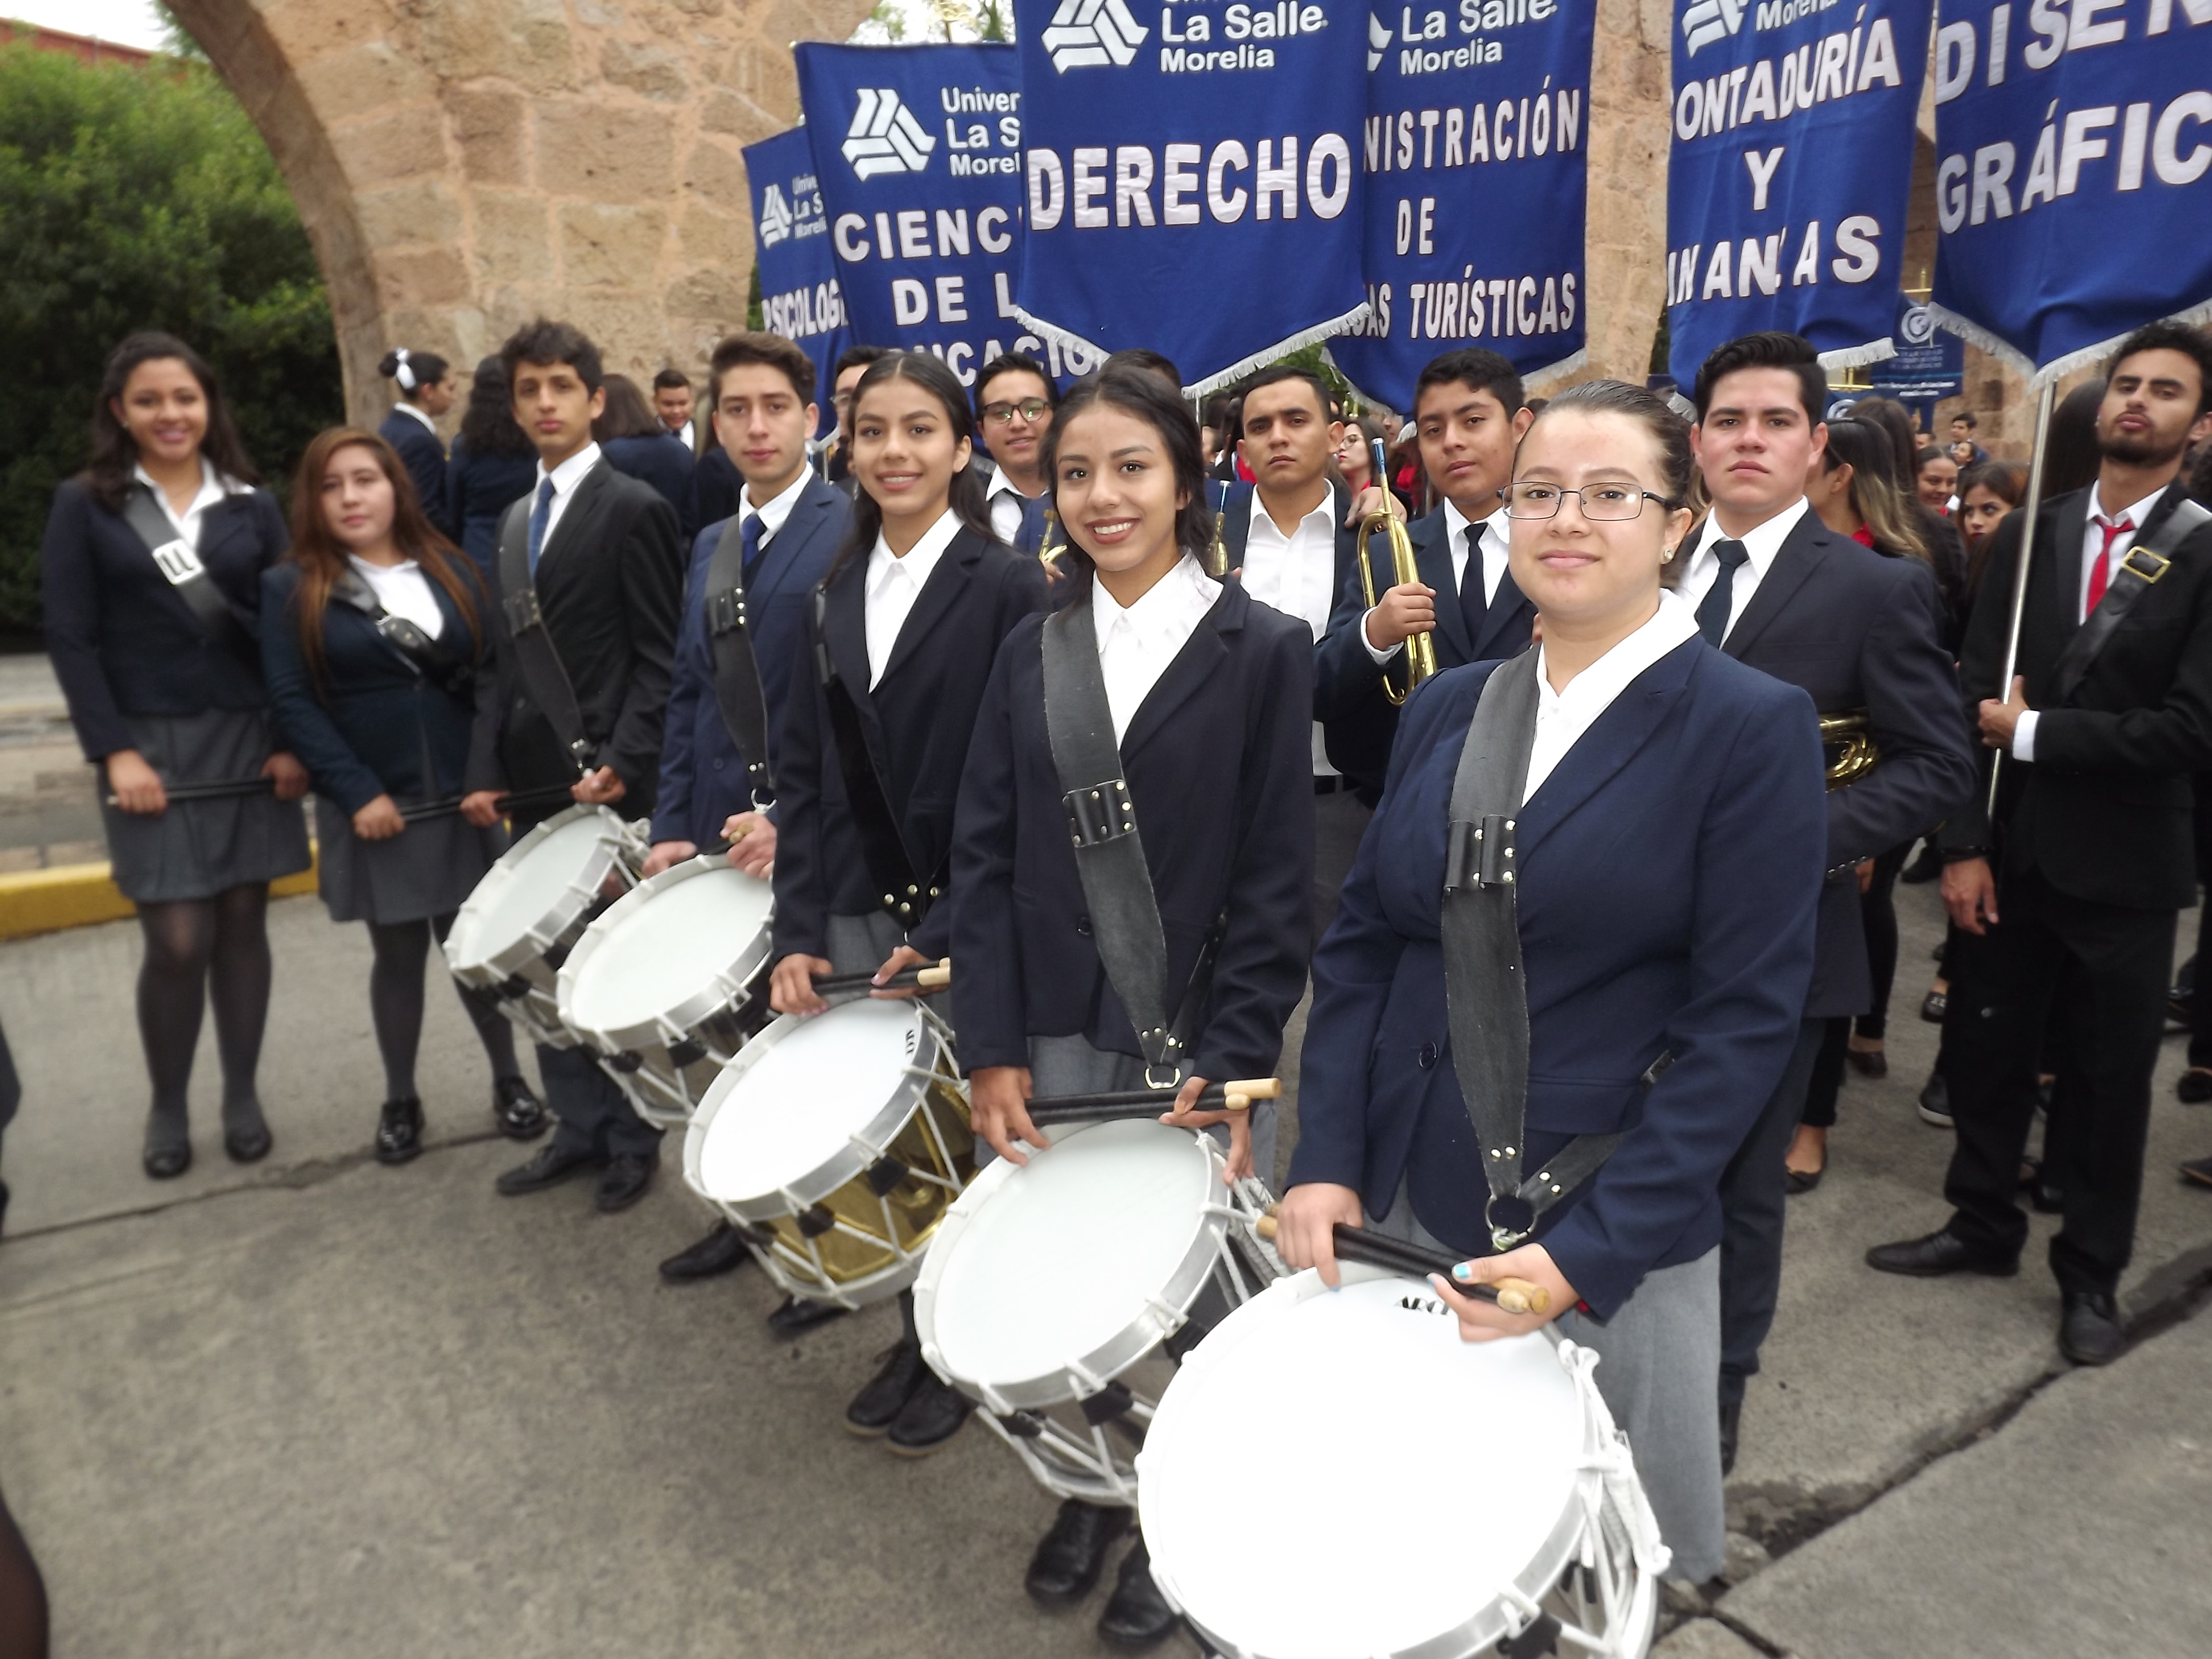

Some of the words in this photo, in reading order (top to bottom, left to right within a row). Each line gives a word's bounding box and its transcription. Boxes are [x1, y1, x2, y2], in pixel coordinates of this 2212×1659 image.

[1162, 7, 1211, 42] La
[1402, 6, 1447, 42] La
[1161, 43, 1276, 73] Morelia
[1401, 38, 1503, 75] Morelia
[941, 86, 1021, 113] Univer
[946, 118, 990, 149] La
[999, 116, 1020, 148] S
[949, 151, 1020, 176] Morel
[1027, 133, 1351, 231] DERECHO
[1744, 147, 1785, 211] Y
[1937, 98, 2212, 234] GRÁFIC
[834, 206, 1022, 262] CIENC
[1396, 198, 1435, 255] DE
[892, 275, 968, 326] DE
[1410, 264, 1576, 339] TURÍSTICAS
